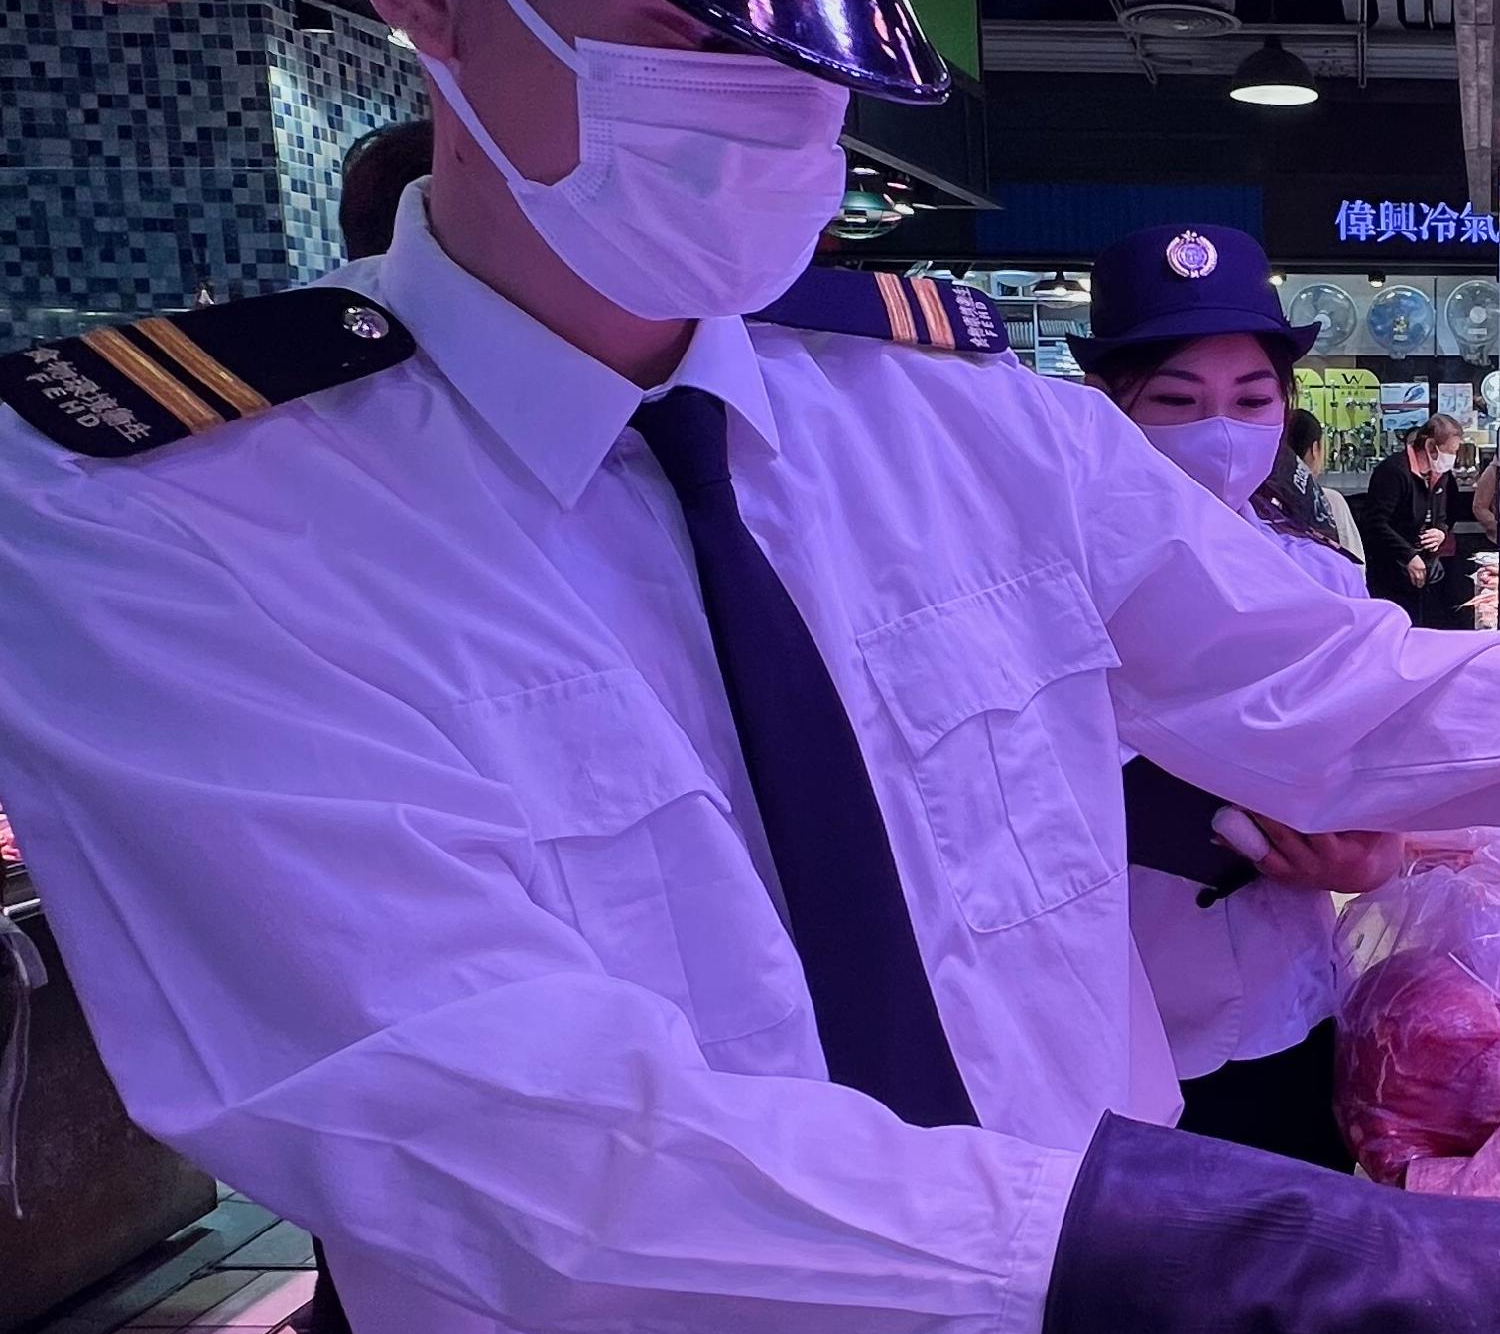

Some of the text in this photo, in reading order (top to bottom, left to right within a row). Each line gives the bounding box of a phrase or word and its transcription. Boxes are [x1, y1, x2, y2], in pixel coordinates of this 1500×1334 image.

[1334, 199, 1500, 243] 偉興冷氣
[974, 301, 999, 338] FEHD
[26, 372, 100, 428] FEHD
